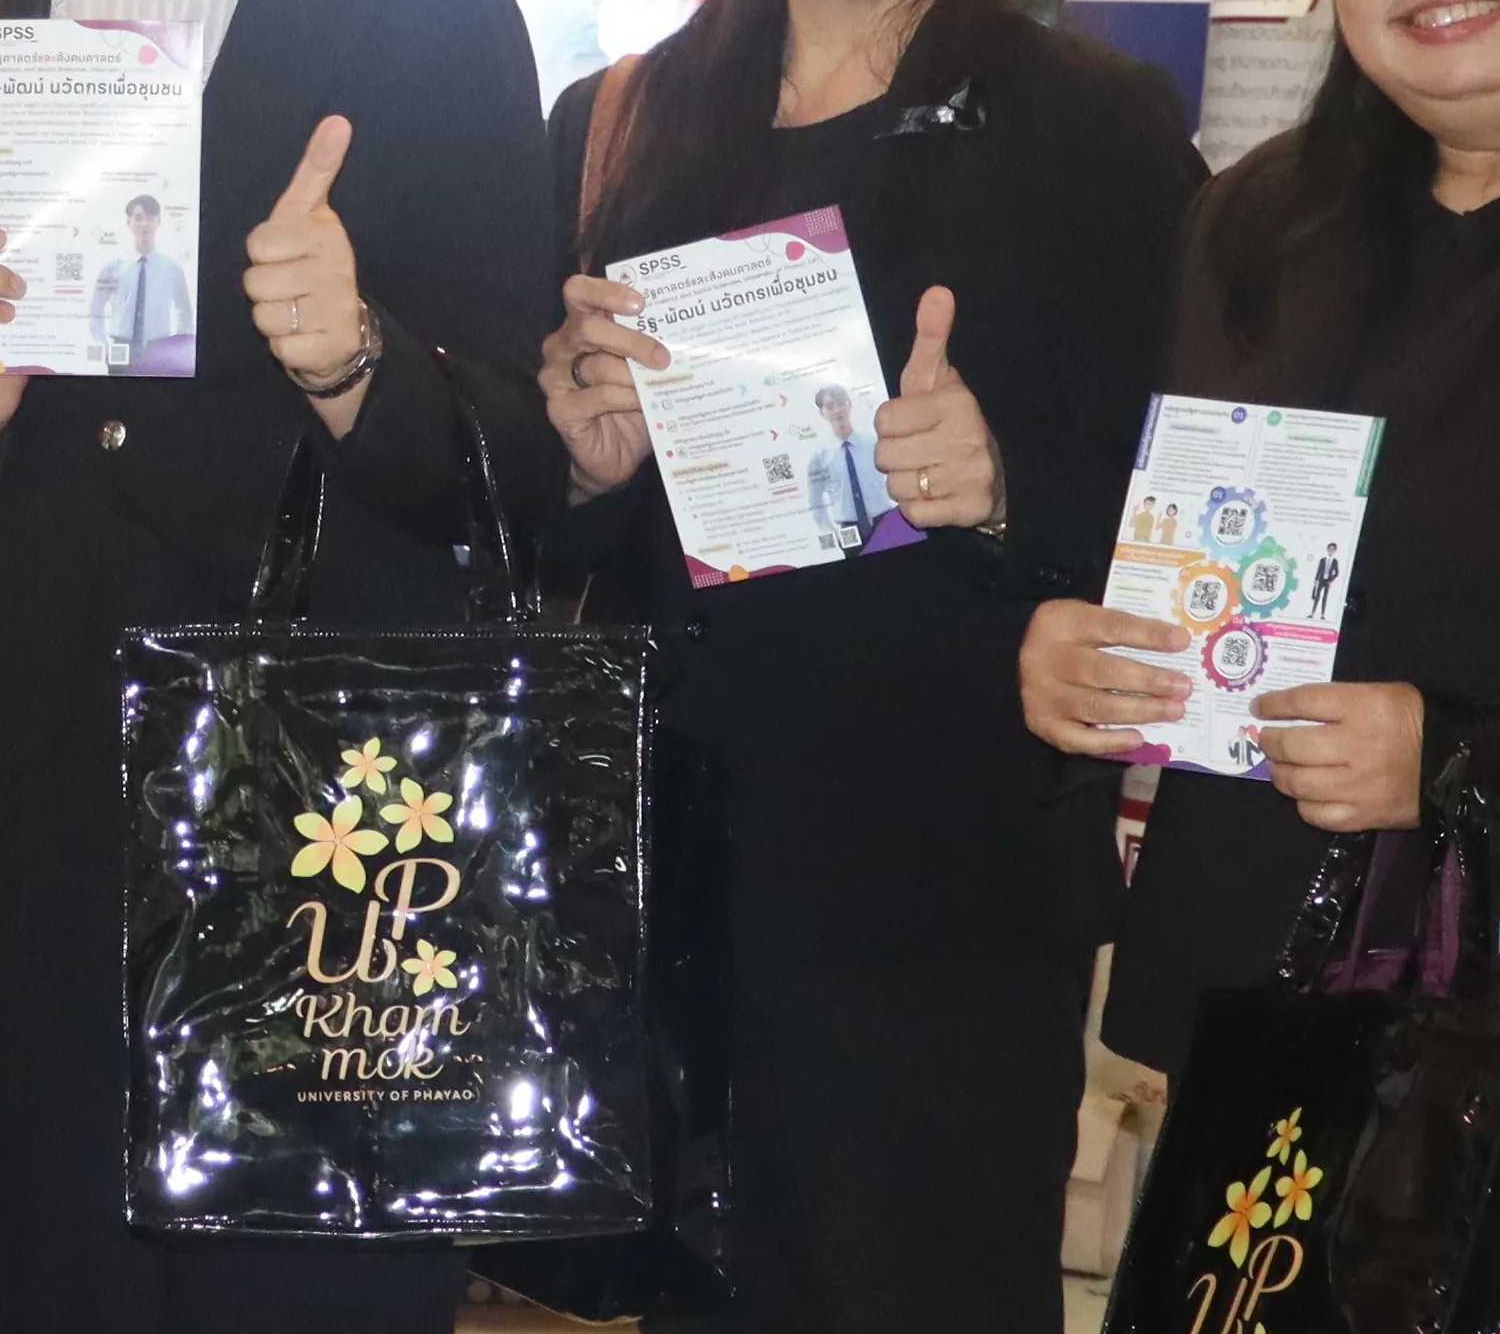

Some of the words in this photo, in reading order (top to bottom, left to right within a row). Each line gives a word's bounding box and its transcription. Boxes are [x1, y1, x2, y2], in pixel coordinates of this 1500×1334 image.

[639, 254, 682, 276] SPSS
[636, 299, 706, 333] รัฐ-พัฒน์
[286, 857, 462, 985] UP
[294, 993, 470, 1039] Kham
[320, 1043, 445, 1082] mok
[297, 1090, 385, 1103] UNIVERSITY
[390, 1090, 409, 1101] OF
[413, 1089, 473, 1101] PHAYAO
